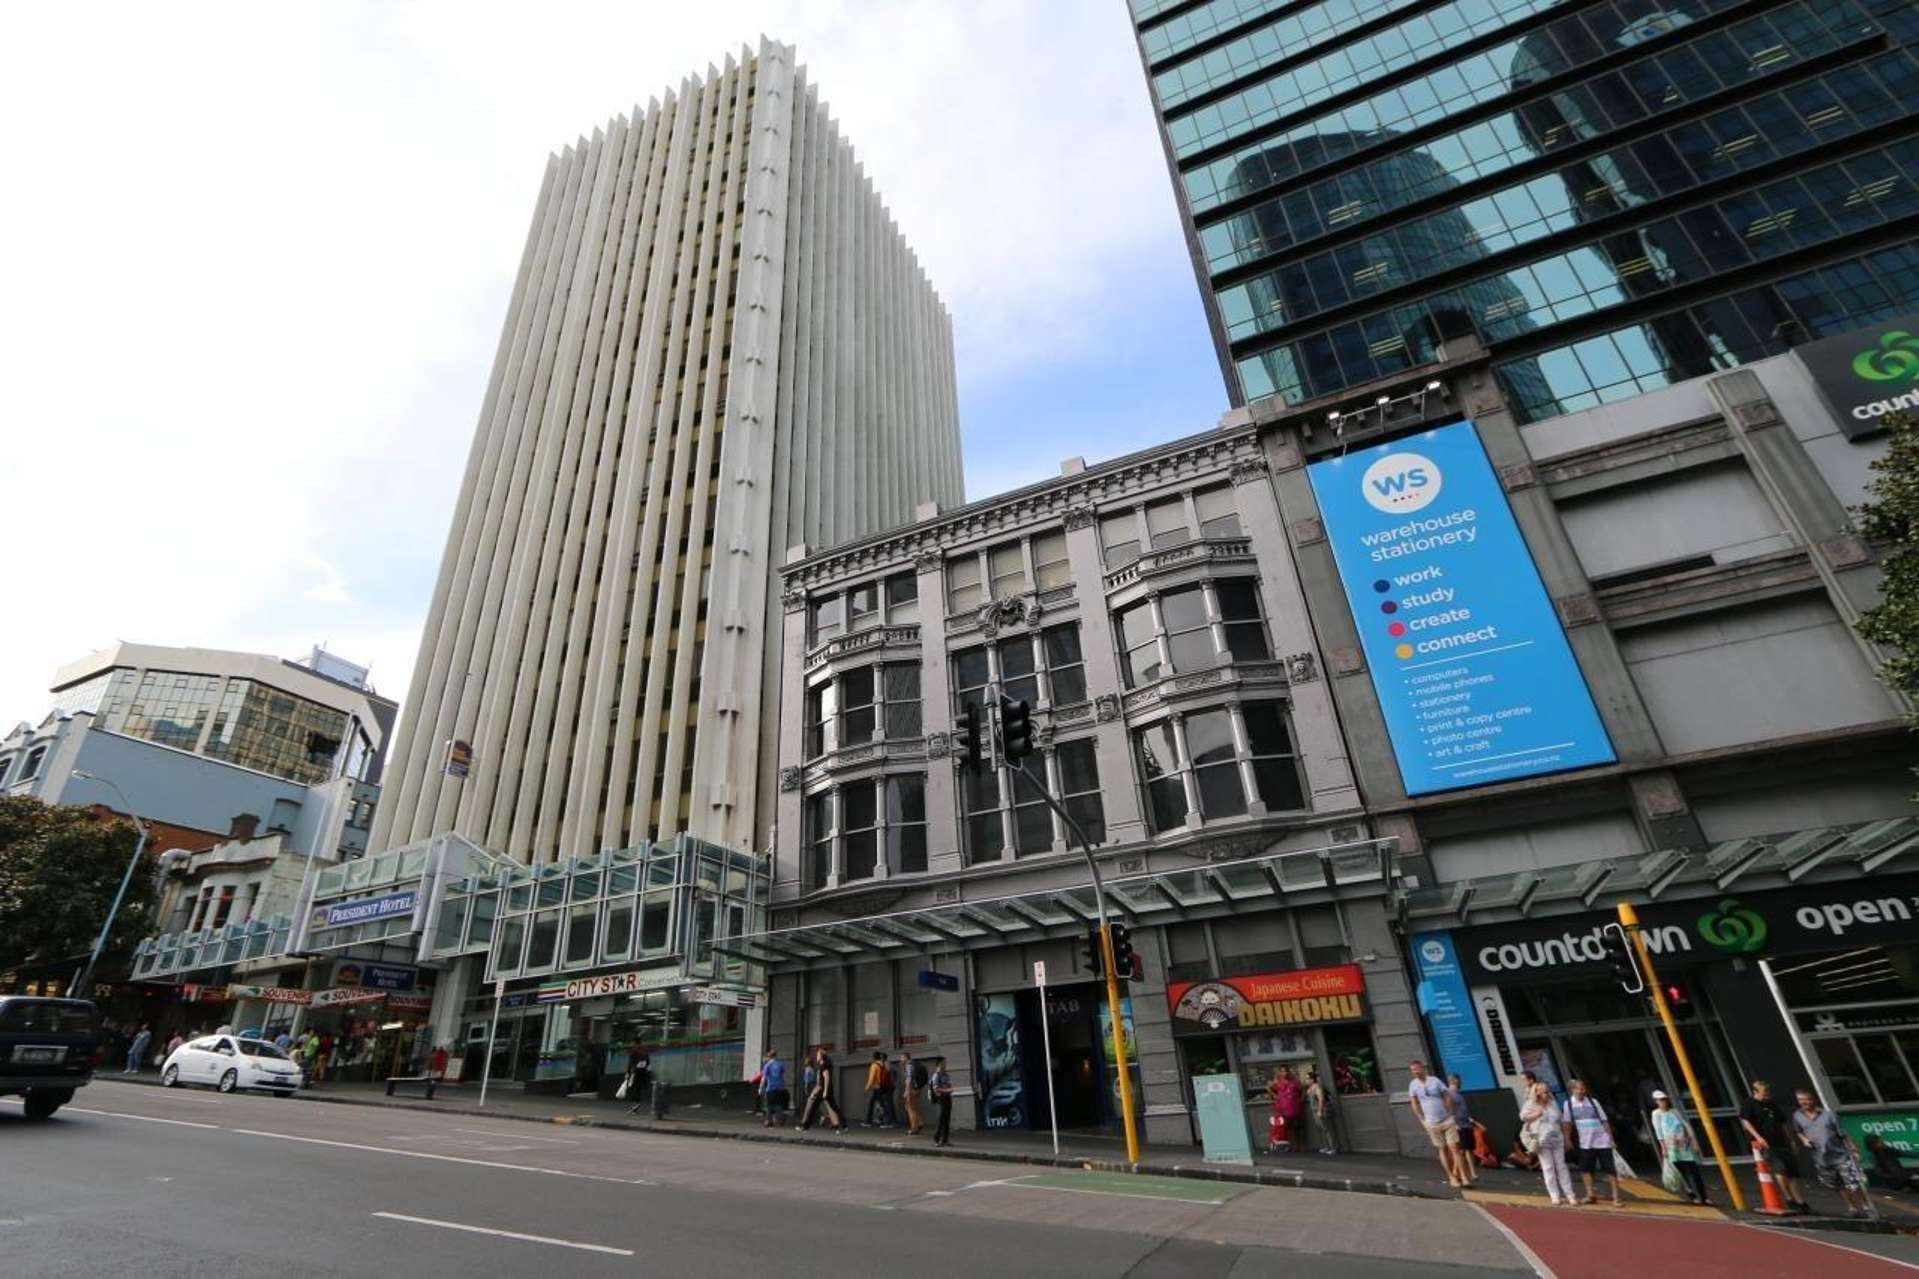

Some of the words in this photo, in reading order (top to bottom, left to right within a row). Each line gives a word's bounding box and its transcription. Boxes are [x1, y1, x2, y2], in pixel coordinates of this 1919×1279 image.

[1372, 467, 1429, 496] WS
[1361, 508, 1477, 547] warehouse
[1370, 525, 1477, 562] stationery
[1394, 565, 1443, 587] work
[1401, 587, 1454, 609] study
[1409, 608, 1471, 631] create
[1417, 625, 1498, 653] connect
[1411, 667, 1469, 685] computers
[1416, 681, 1451, 696] mobile
[1454, 674, 1495, 690] phones
[1420, 691, 1471, 708] stationery
[1422, 704, 1471, 720] furniture
[1427, 720, 1453, 734] print
[1466, 712, 1494, 727] copy
[1496, 705, 1532, 720] centre
[1431, 731, 1465, 746] photo
[1467, 725, 1502, 739] centre
[1436, 747, 1451, 758] art
[1464, 740, 1490, 753] craft
[330, 904, 379, 924] PRESIDENT
[379, 896, 412, 914] HOTEL
[1796, 897, 1912, 935] open
[1478, 925, 1692, 972] countdwn
[567, 977, 600, 998] CITY
[1251, 980, 1301, 998] Japanese
[1302, 974, 1345, 992] Cuisine
[1046, 999, 1081, 1015] TAB
[1237, 994, 1362, 1027] DAIKOKU
[1861, 1121, 1906, 1136] open
[1906, 1117, 1918, 1131] 7
